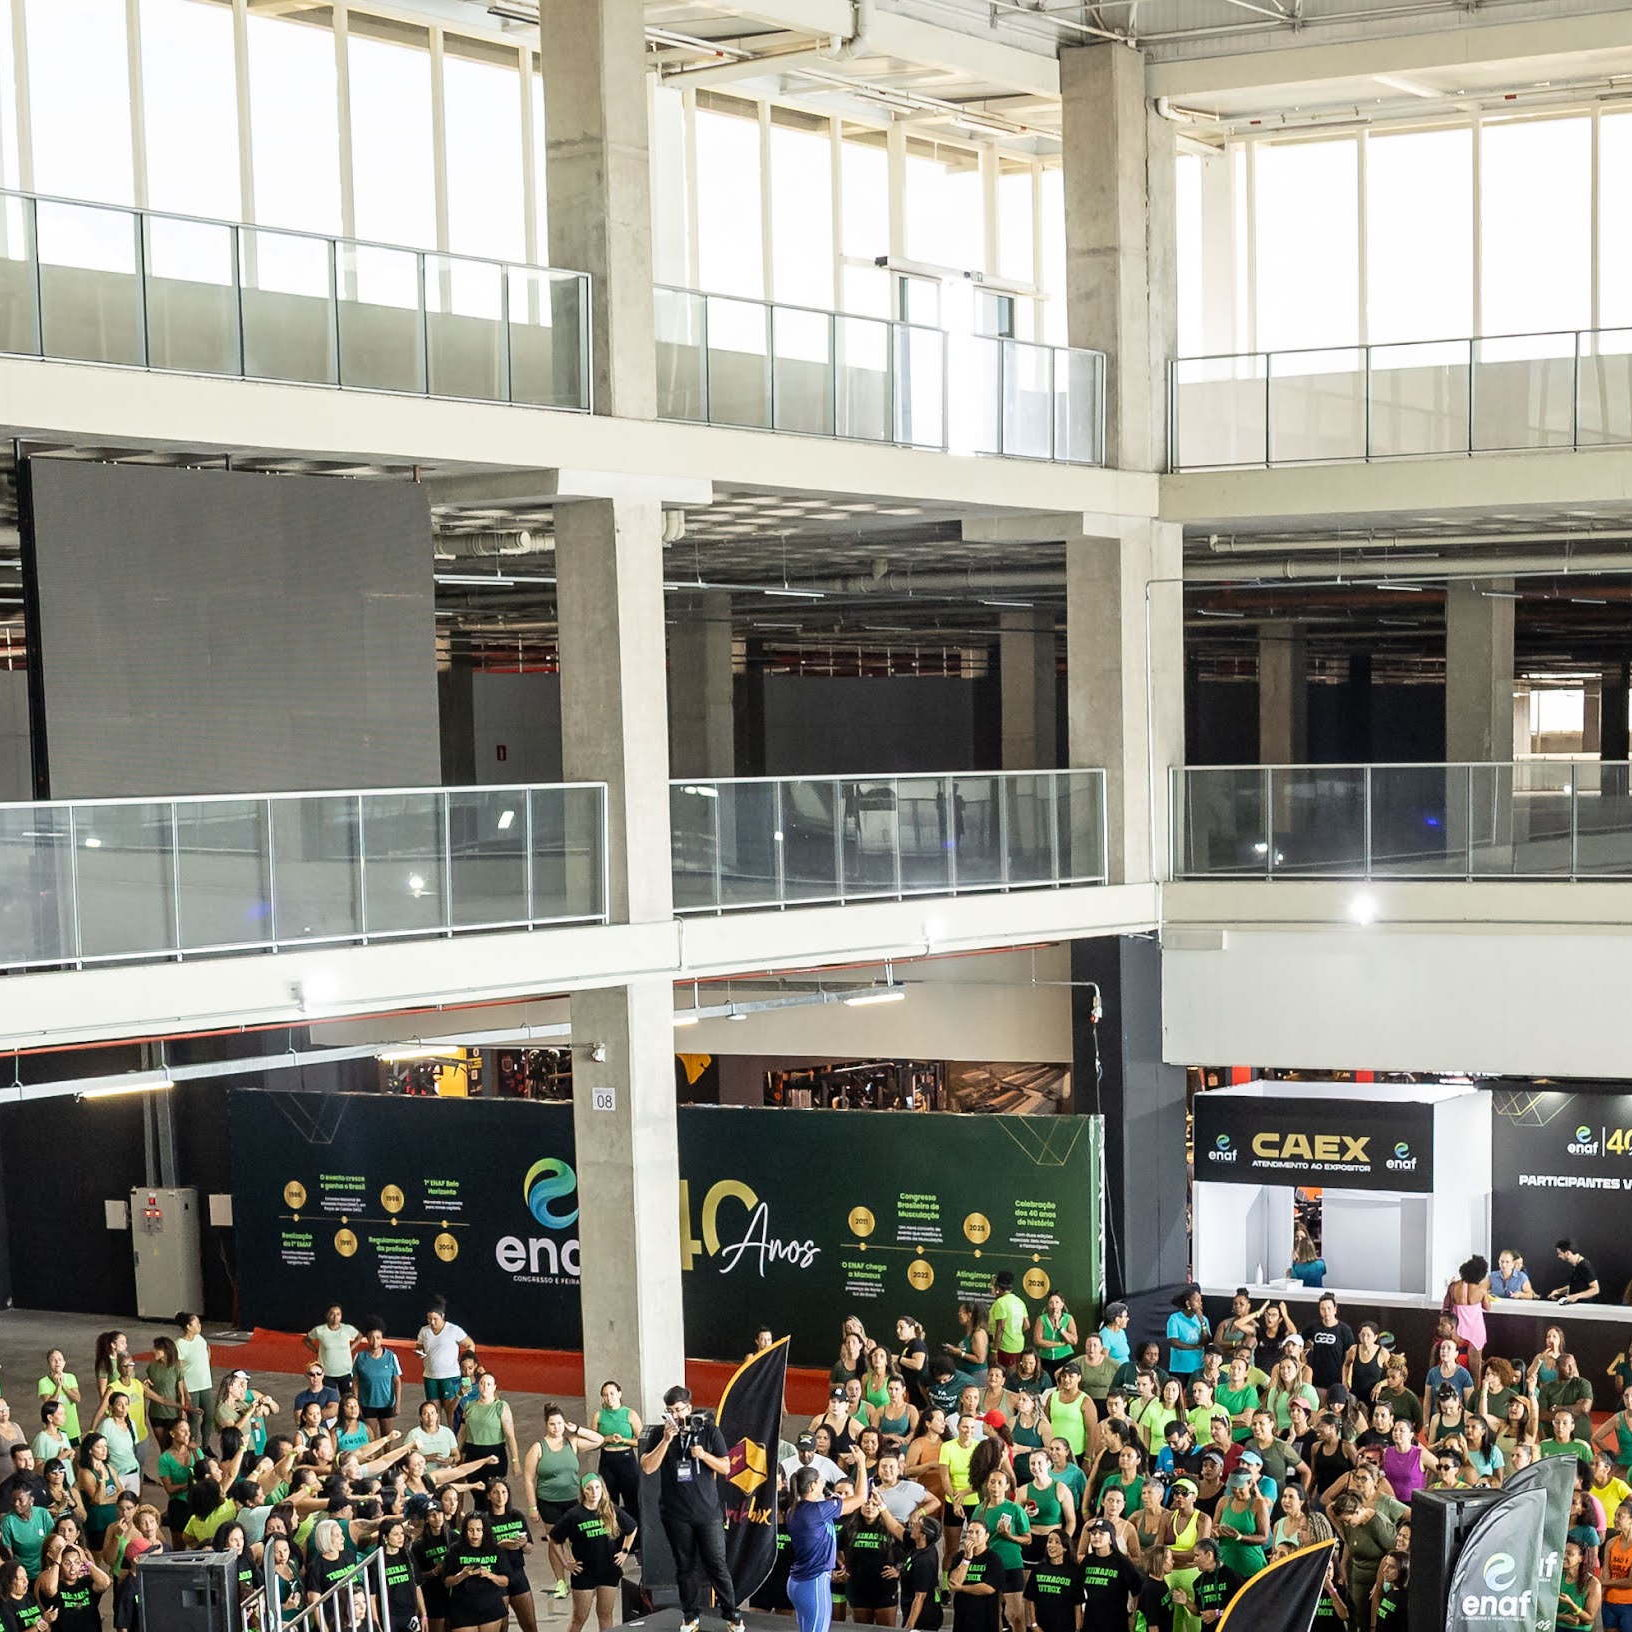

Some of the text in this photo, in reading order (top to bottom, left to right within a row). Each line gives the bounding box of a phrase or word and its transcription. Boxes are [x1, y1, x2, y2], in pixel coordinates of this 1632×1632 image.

[597, 1095, 613, 1109] 08
[1251, 1132, 1371, 1163] CAEX
[1567, 1140, 1599, 1156] enaf
[1208, 1149, 1238, 1162] enaf
[1252, 1159, 1371, 1173] ATENDIMENTO AO EXPOSITOR
[1385, 1157, 1418, 1171] enaf
[1518, 1174, 1621, 1191] PARTICIPANTES
[899, 1193, 937, 1203] Congresso
[897, 1201, 929, 1210] Brasileiro
[1014, 1200, 1057, 1210] Celebração
[897, 1210, 940, 1220] Musculação
[1014, 1209, 1027, 1217] dos
[1039, 1211, 1057, 1219] anos
[1027, 1218, 1055, 1228] história
[718, 1201, 822, 1278] Anos
[956, 1270, 992, 1280] Atingimos
[1462, 1589, 1532, 1617] enaf
